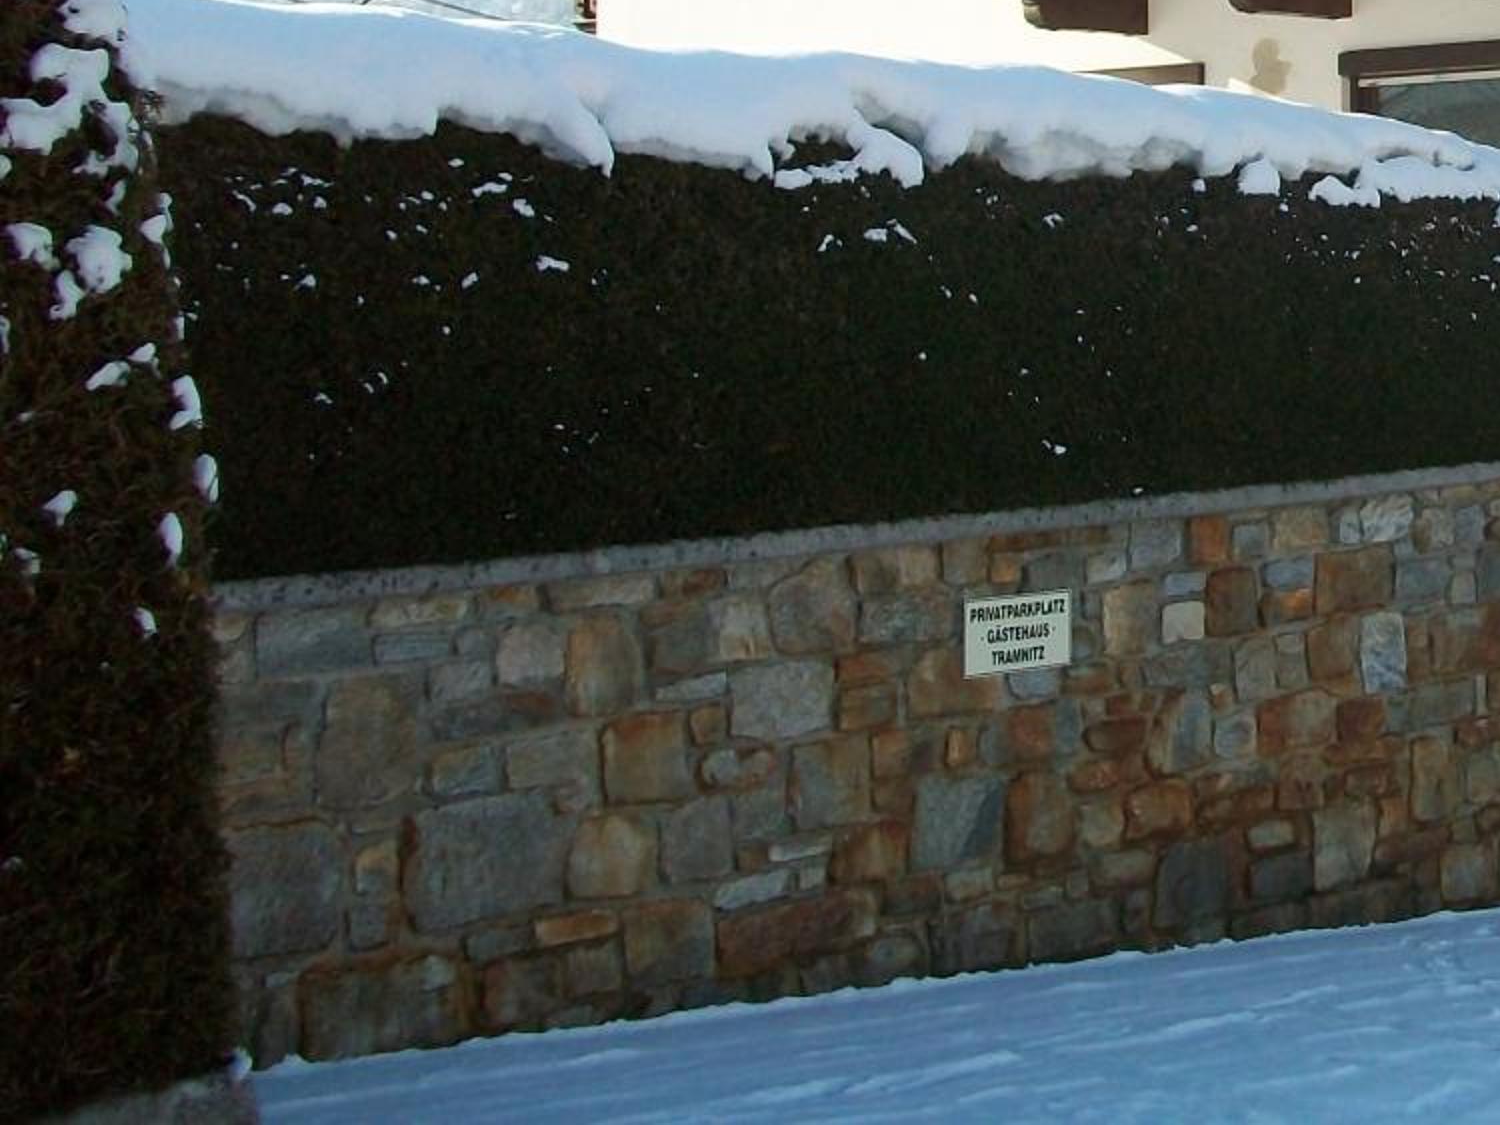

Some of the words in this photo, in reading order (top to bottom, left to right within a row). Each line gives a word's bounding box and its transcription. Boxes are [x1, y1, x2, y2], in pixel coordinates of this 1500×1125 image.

[969, 598, 1066, 623] PRIVATPARKPLATZ
[986, 623, 1051, 644] GÄSTEHAUS
[991, 645, 1045, 666] TRAMNITZ
